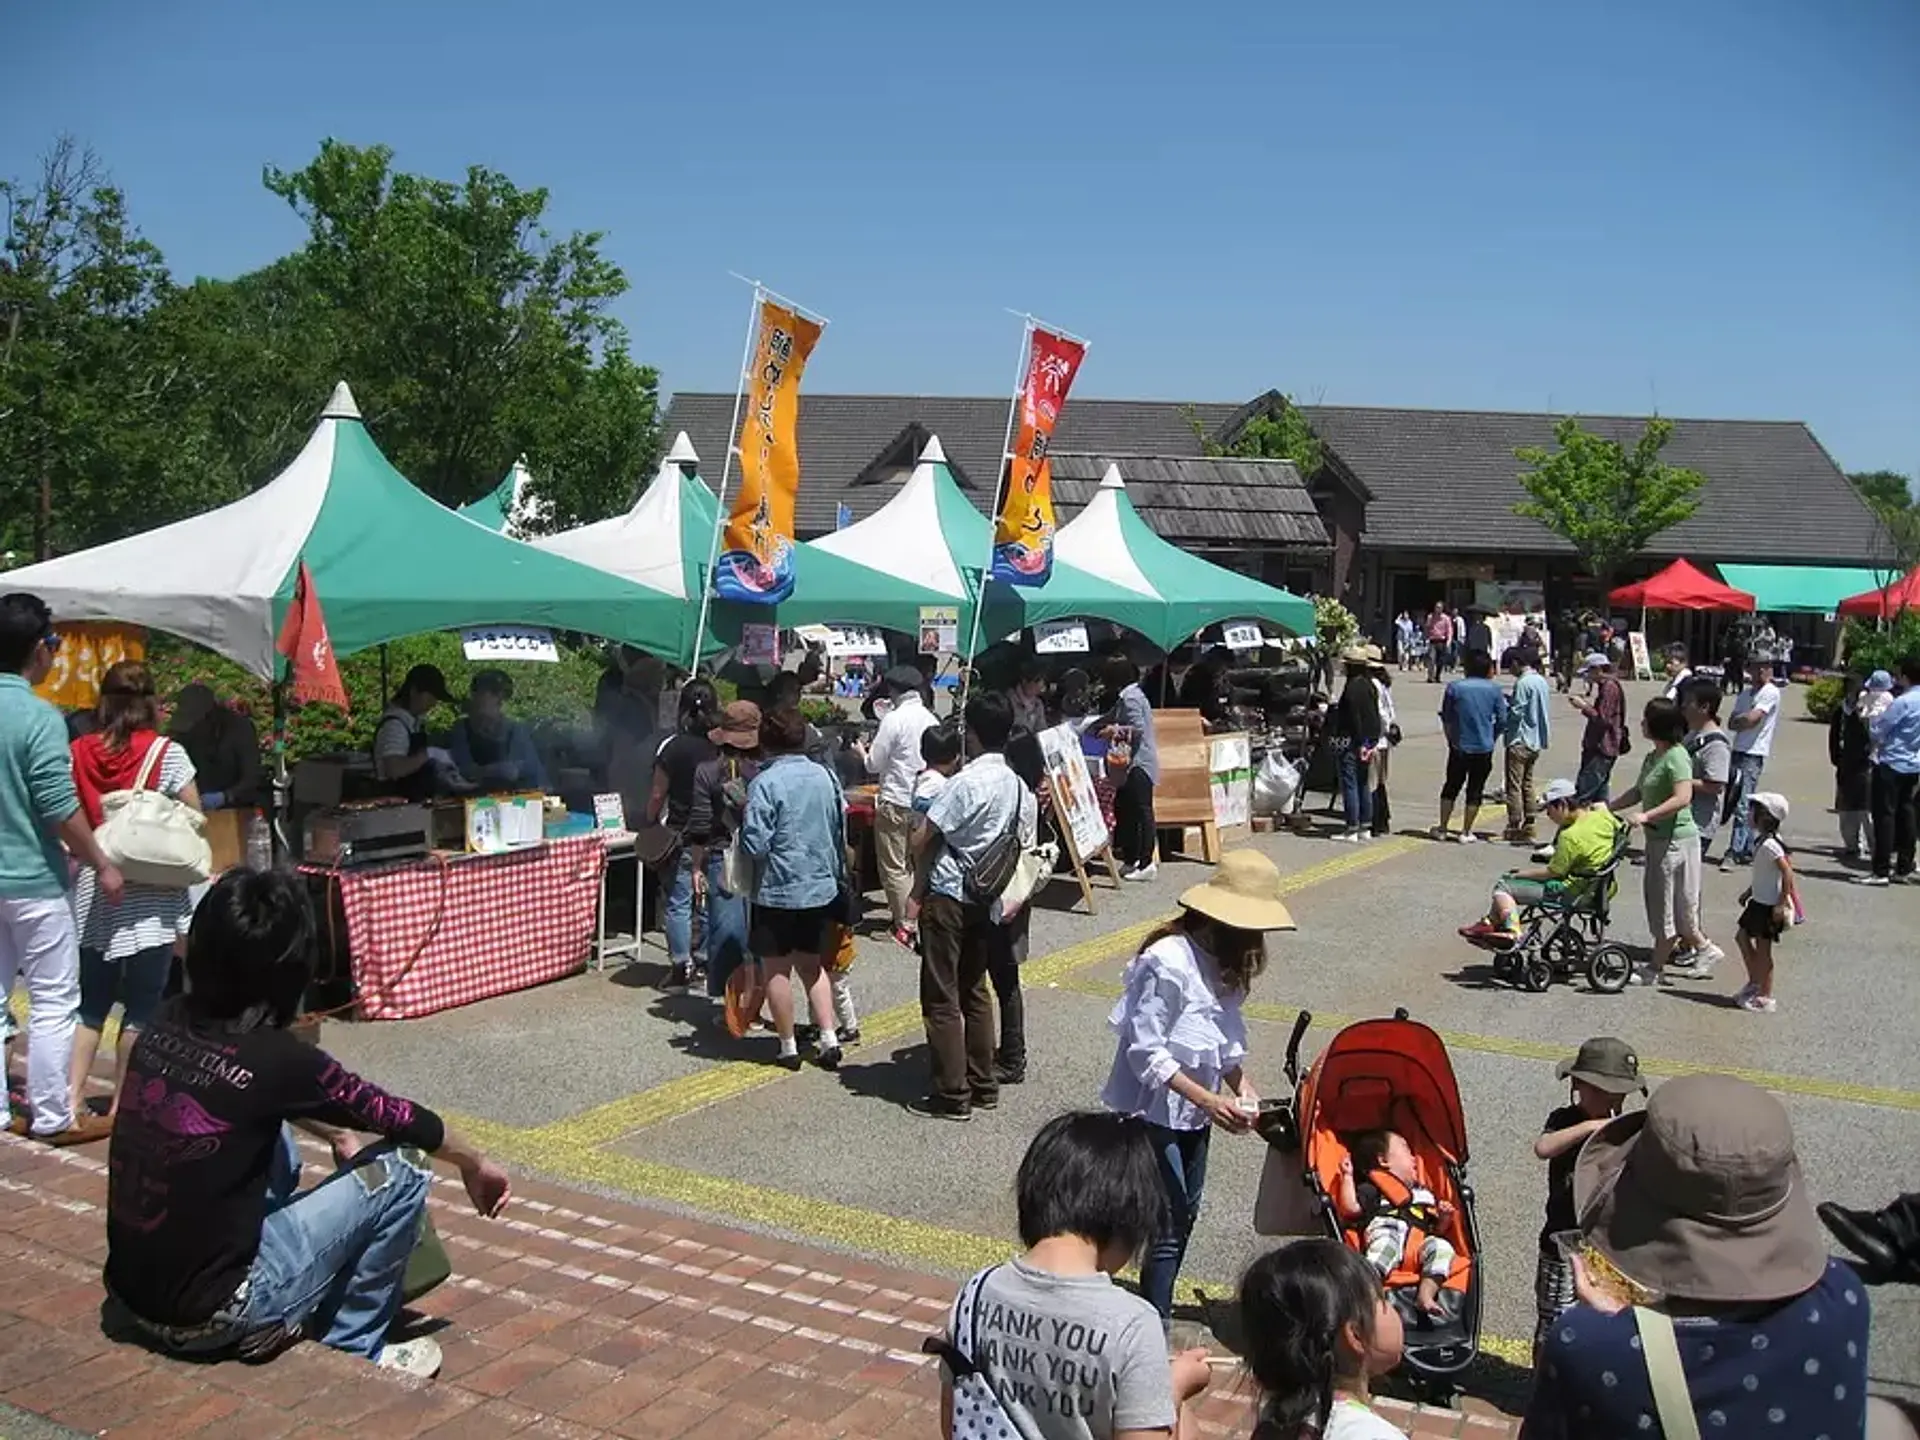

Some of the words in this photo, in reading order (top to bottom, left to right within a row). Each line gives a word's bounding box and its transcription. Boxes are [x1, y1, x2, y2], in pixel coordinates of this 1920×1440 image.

[199, 1051, 253, 1089] TIME
[977, 1301, 1043, 1341] HANK
[1051, 1318, 1108, 1356] YOU
[981, 1337, 1038, 1376] ANK
[1045, 1351, 1098, 1389] YOU
[1043, 1390, 1094, 1418] YOU
